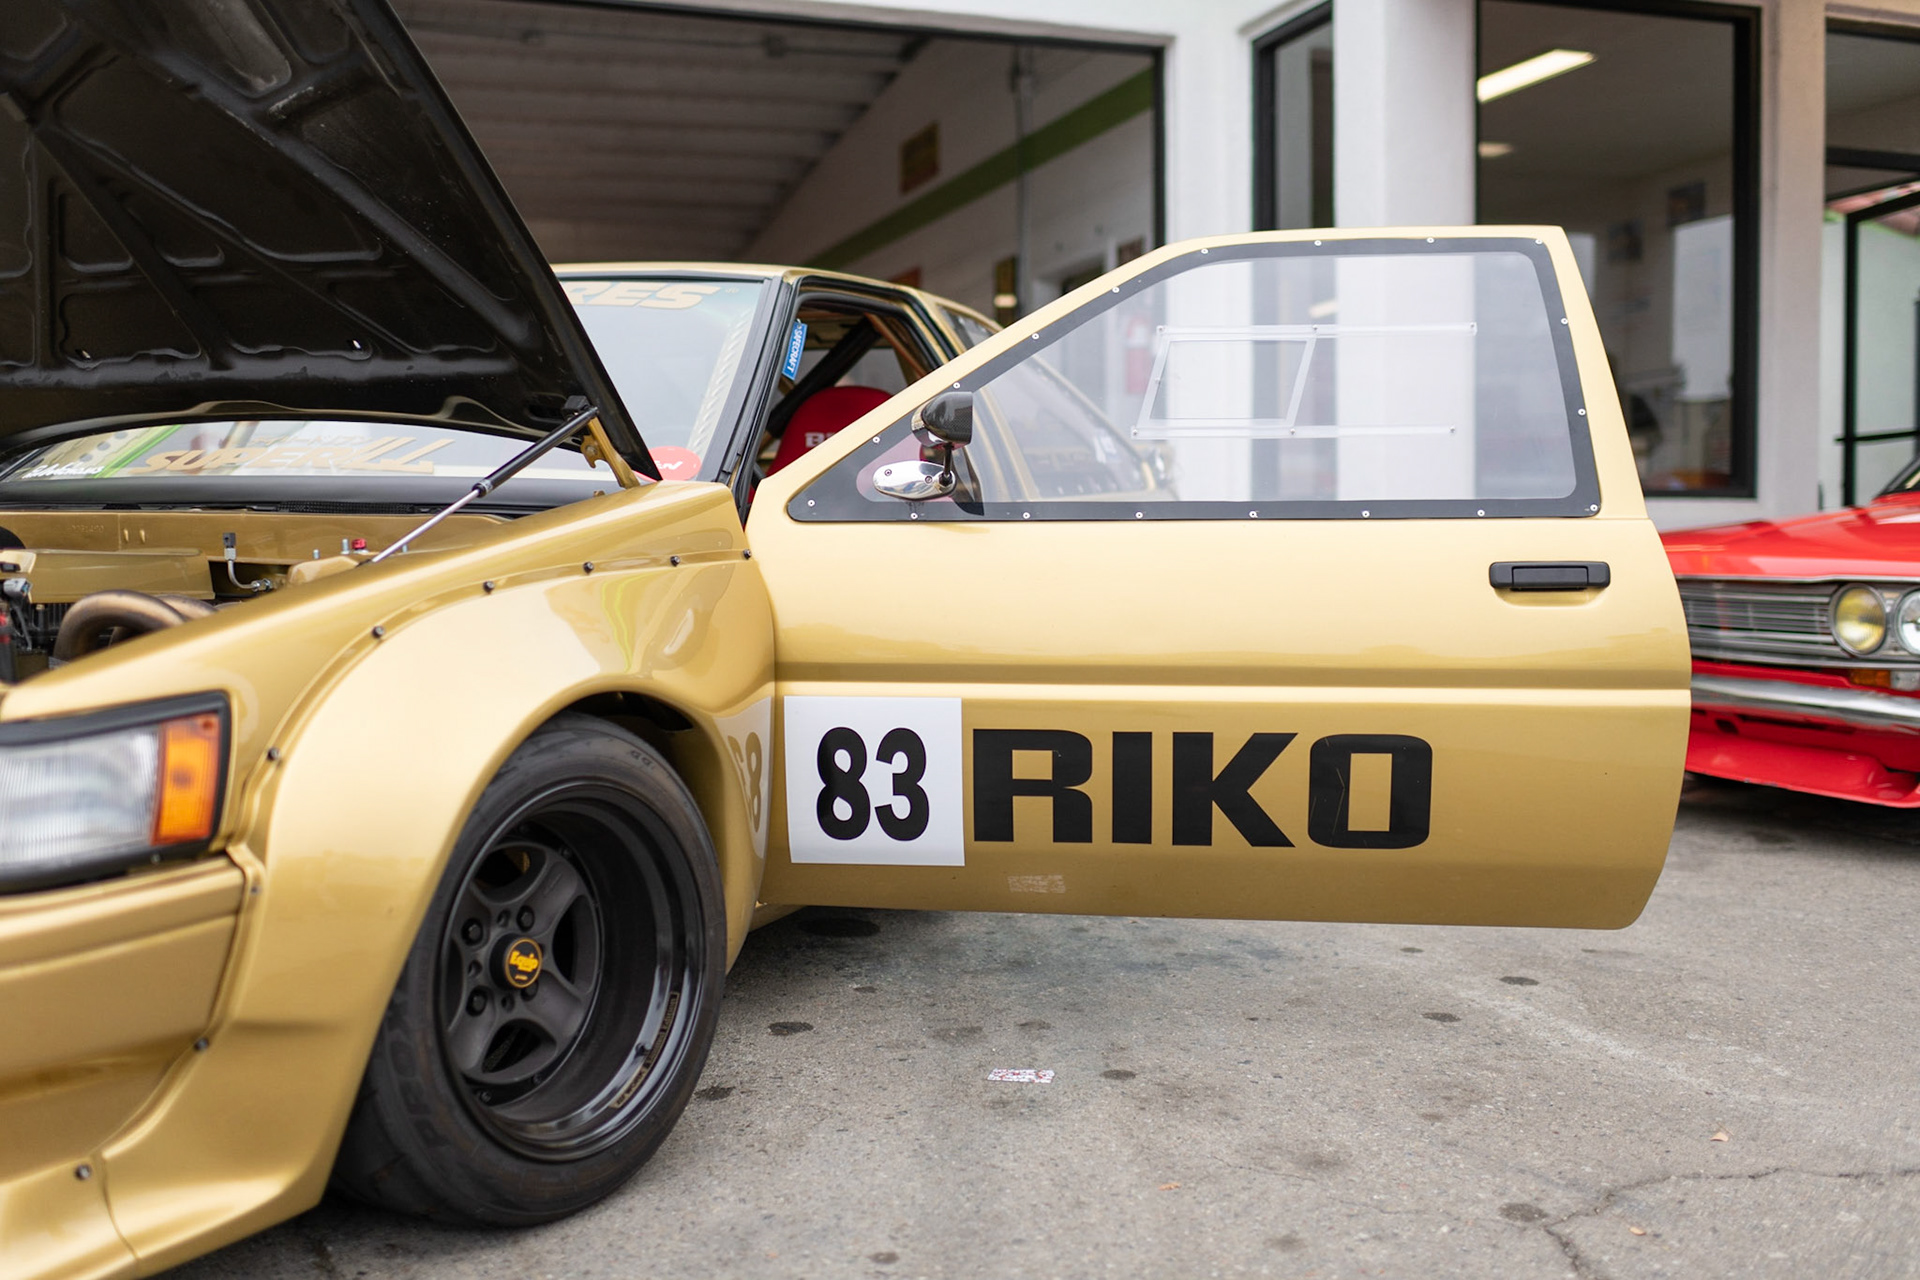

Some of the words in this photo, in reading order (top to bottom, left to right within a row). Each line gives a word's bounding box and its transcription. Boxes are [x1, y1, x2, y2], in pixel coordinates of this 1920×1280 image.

[787, 329, 803, 373] SAFECRAFT
[816, 726, 930, 842] 83
[972, 728, 1434, 850] RIKO
